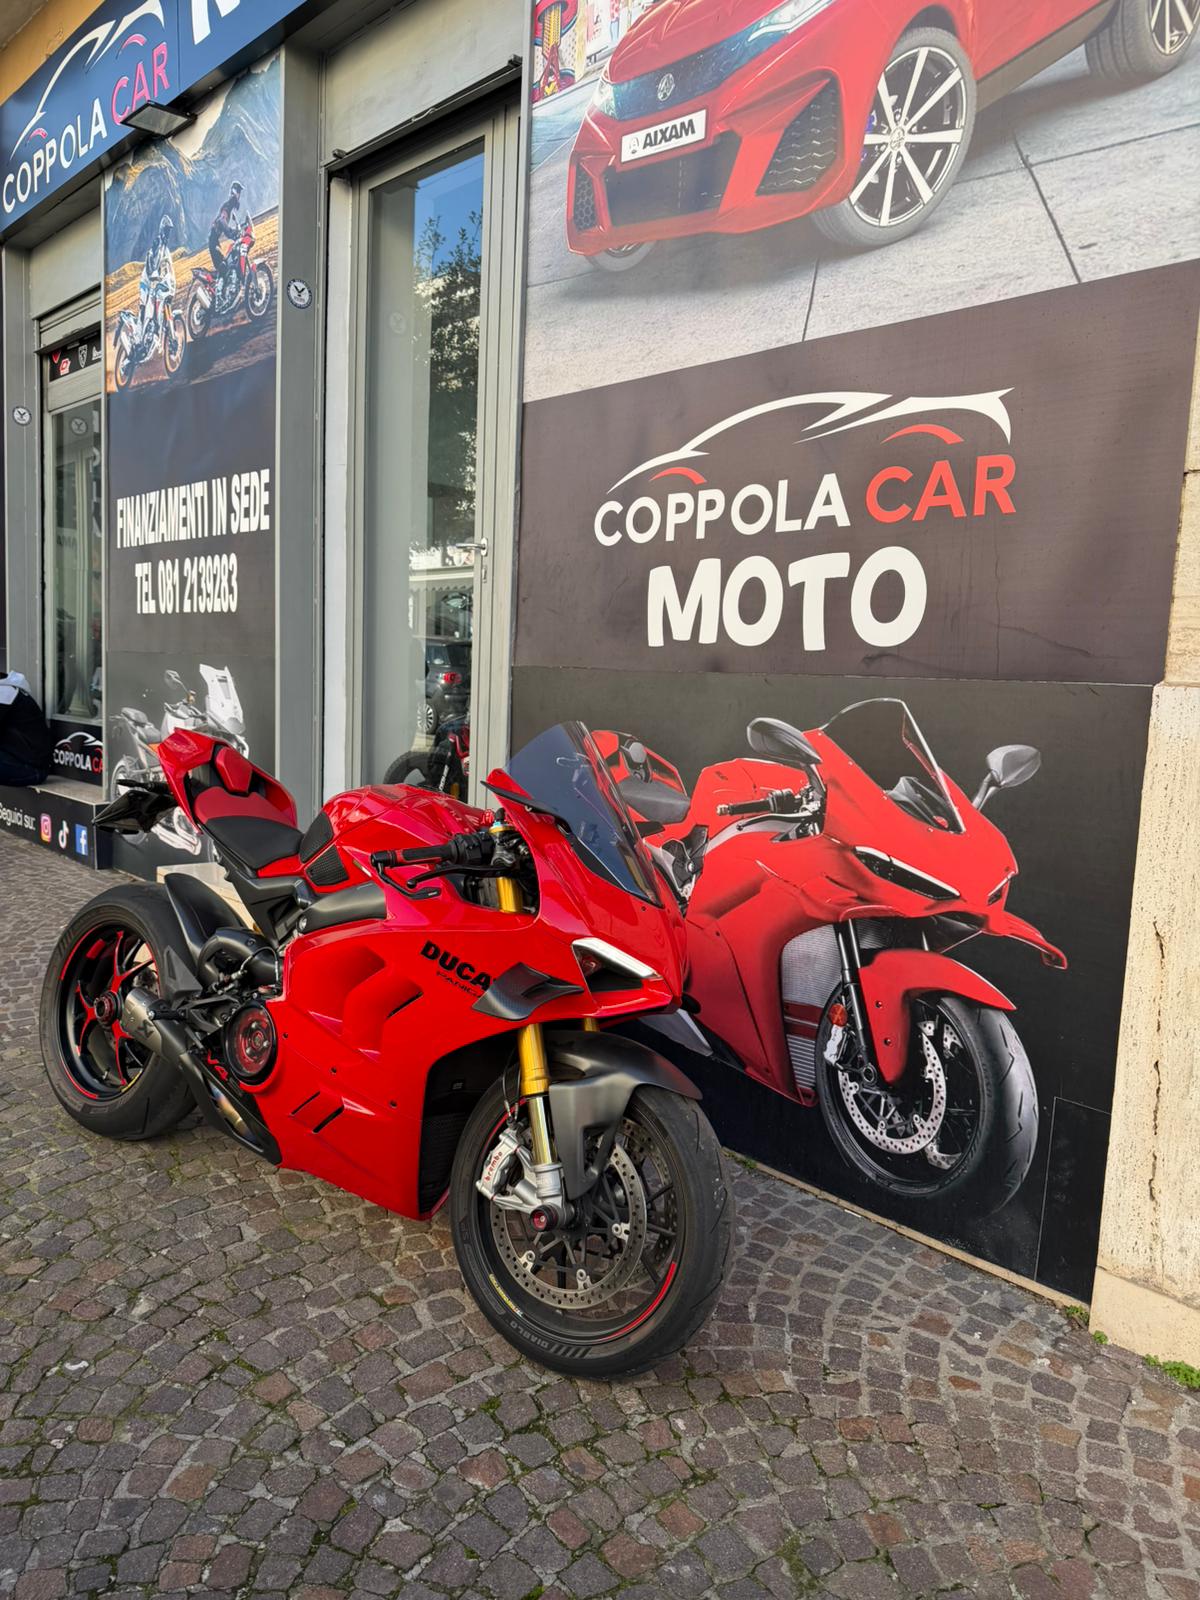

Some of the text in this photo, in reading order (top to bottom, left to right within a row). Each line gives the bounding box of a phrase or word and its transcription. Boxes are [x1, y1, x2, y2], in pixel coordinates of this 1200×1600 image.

[3, 42, 170, 213] COPPOLA CAR
[642, 118, 696, 150] AIXAM
[117, 468, 270, 549] FINANZIAMENTI IN SEDE
[594, 454, 1016, 546] COPPOLA CAR
[135, 553, 238, 614] TEL 081 2139283
[647, 546, 927, 651] MOTO
[53, 749, 104, 773] COPPOLA CA
[420, 940, 492, 992] DUCA
[509, 1320, 550, 1349] DIABLO
